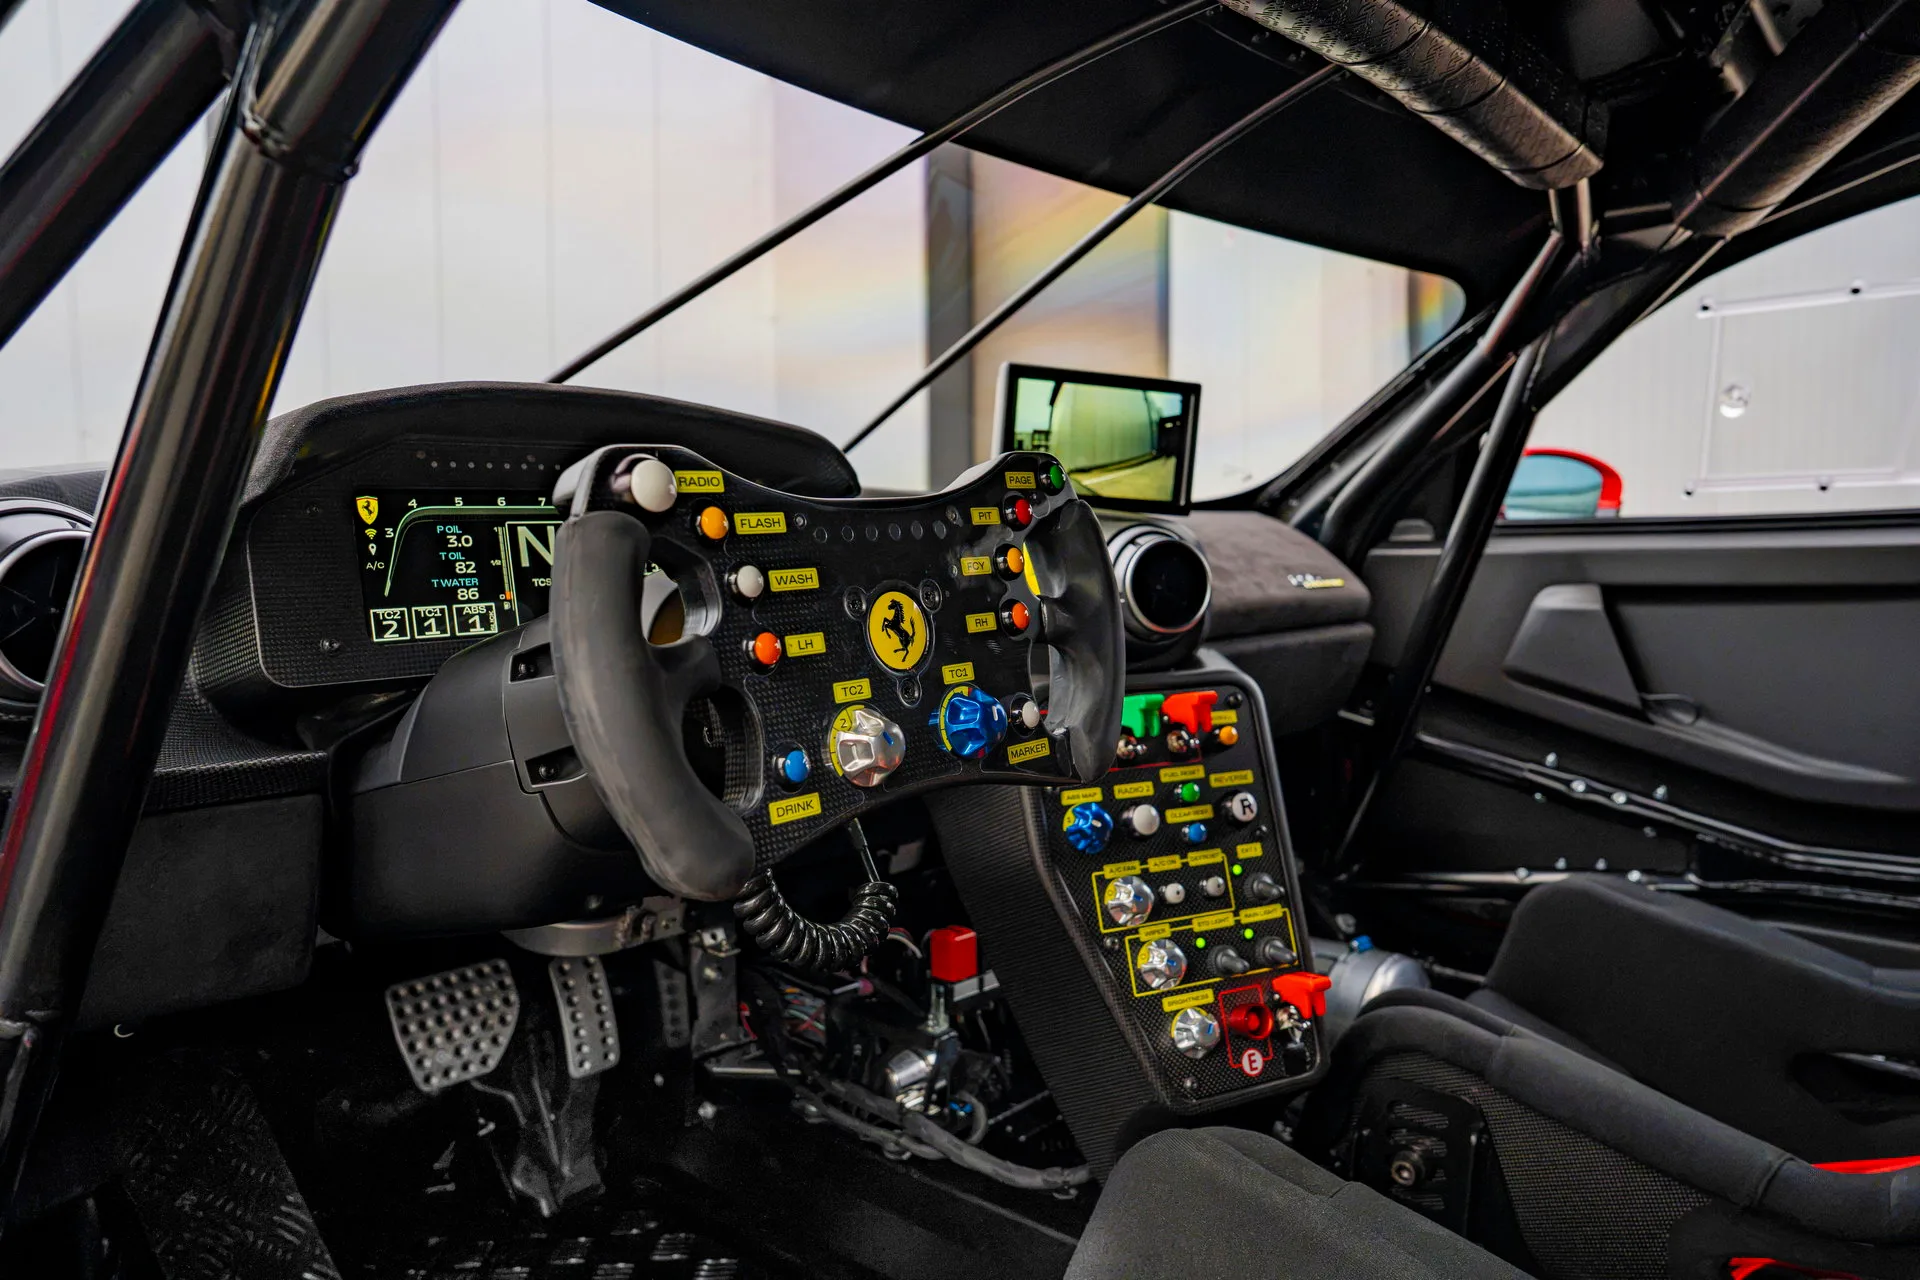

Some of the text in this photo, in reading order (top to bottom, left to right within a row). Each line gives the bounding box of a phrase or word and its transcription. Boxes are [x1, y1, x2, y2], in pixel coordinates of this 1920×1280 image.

[678, 476, 721, 488] RADIO
[1009, 475, 1033, 485] PAGE
[408, 498, 418, 509] 4
[454, 497, 463, 507] 5
[497, 497, 506, 506] 6
[538, 497, 546, 507] 7
[978, 511, 992, 521] PIT
[740, 518, 781, 529] FLASH
[384, 528, 394, 538] 3
[437, 525, 462, 534] P OIL
[446, 535, 473, 548] 3.0
[517, 525, 555, 567] N
[439, 551, 466, 561] T OIL
[366, 561, 385, 571] A/C
[455, 561, 477, 574] 82
[967, 561, 985, 571] FCY
[431, 577, 479, 588] T WATER
[774, 574, 814, 586] WASH
[457, 588, 480, 601] 86
[376, 610, 402, 620] TC2
[417, 608, 442, 618] TC1
[462, 605, 487, 615] ABS
[423, 617, 441, 636] 1
[468, 614, 485, 633] 1
[975, 617, 989, 628] RH
[382, 620, 400, 639] 2
[797, 639, 815, 651] LH
[949, 669, 969, 679] TC1
[841, 684, 865, 697] TC2
[840, 719, 848, 729] 2
[1010, 742, 1047, 759] MARKER
[1118, 786, 1144, 795] RADIO
[776, 800, 815, 818] DRINK
[1240, 798, 1255, 816] R
[1167, 993, 1209, 1007] BRIGHTNESS
[1247, 1052, 1259, 1072] E
